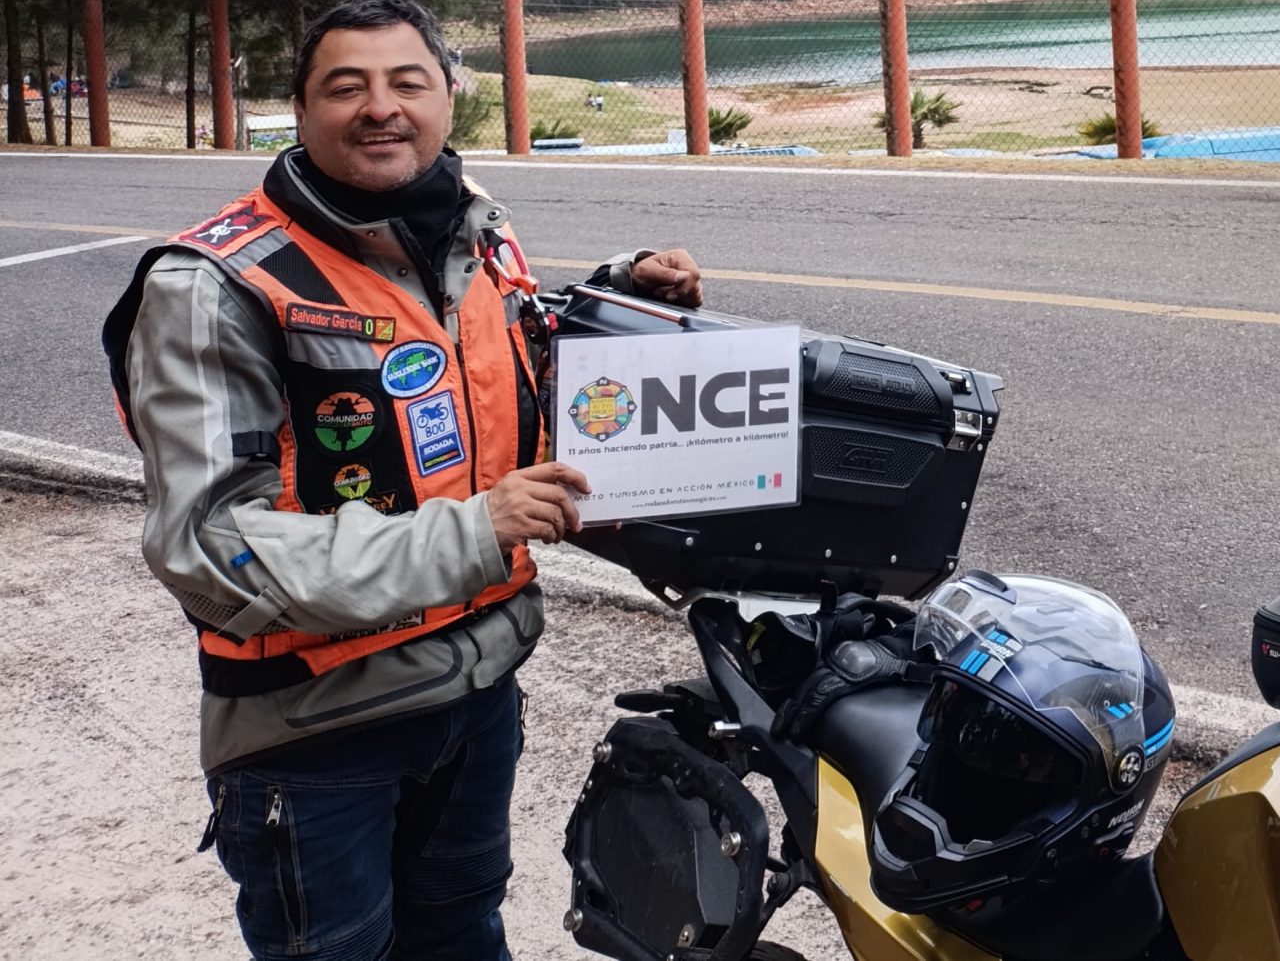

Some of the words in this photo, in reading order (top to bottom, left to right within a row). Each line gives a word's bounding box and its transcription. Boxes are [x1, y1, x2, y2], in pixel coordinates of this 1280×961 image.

[291, 308, 330, 327] Salvador
[332, 314, 363, 332] García
[317, 412, 374, 423] COMUNIDAD
[425, 421, 446, 438] 800
[423, 438, 455, 455] RODADA
[568, 448, 576, 456] 11
[578, 446, 602, 455] años
[604, 441, 648, 453] haciendo
[573, 493, 605, 502] MOTO
[609, 489, 656, 500] TURISMO
[659, 486, 673, 496] EN
[1107, 799, 1144, 829] NOLAN
